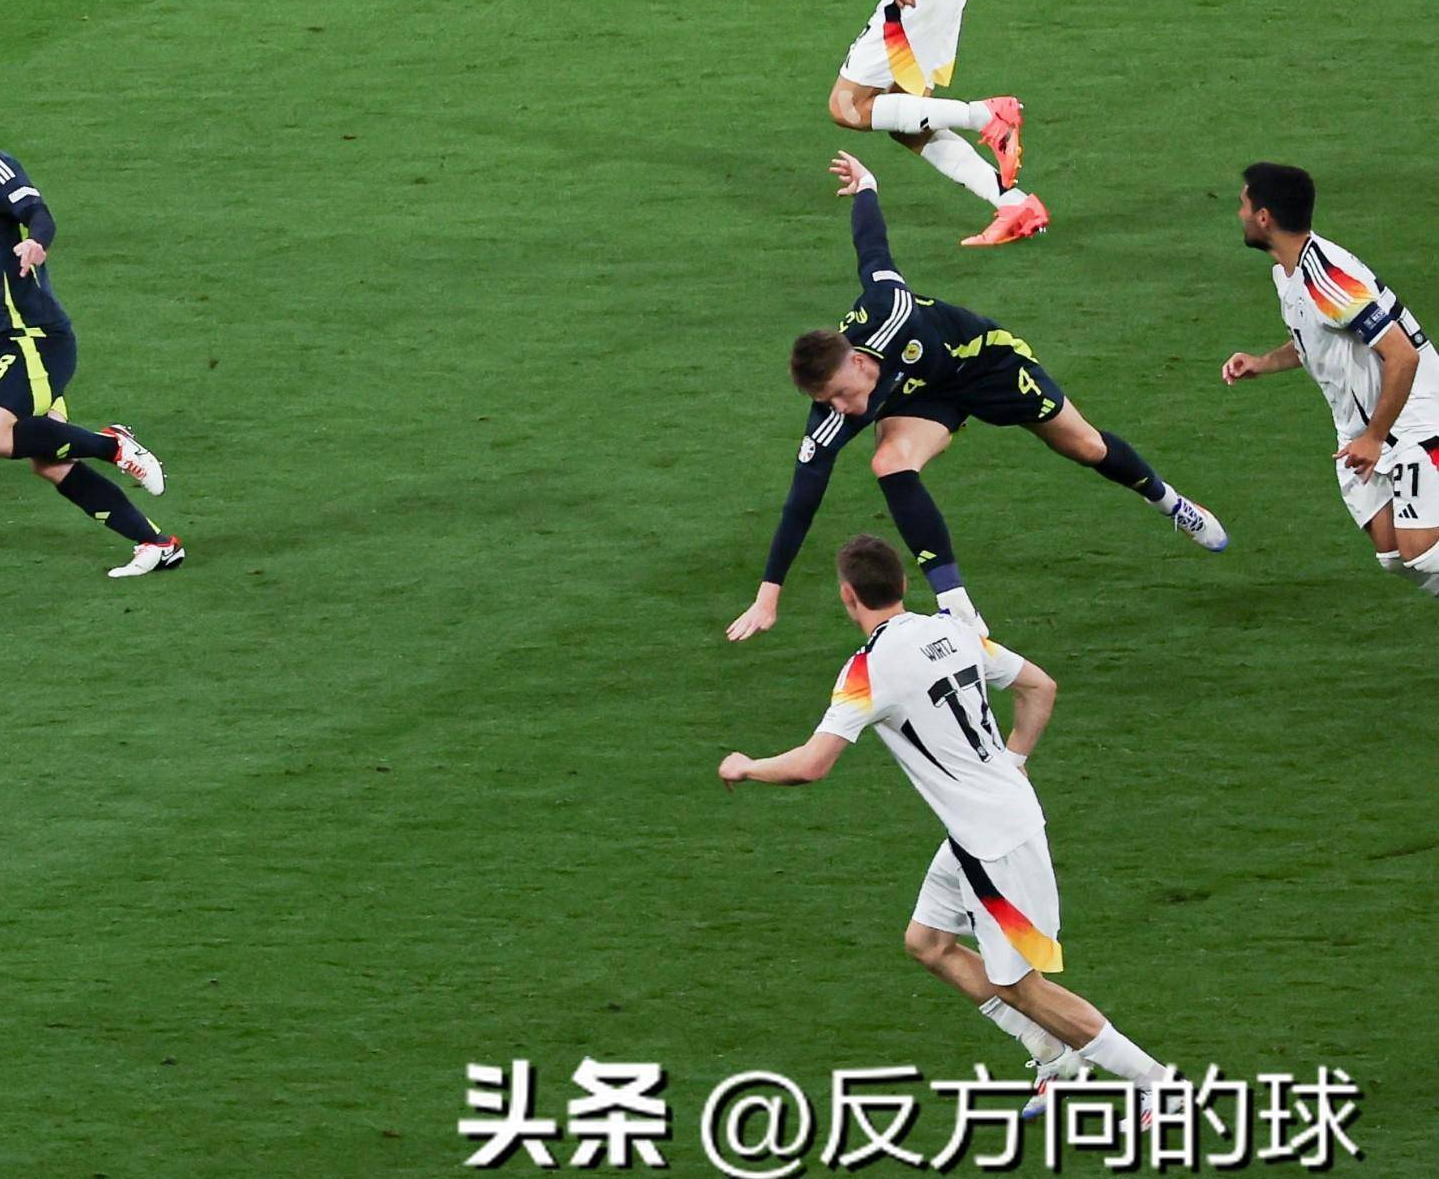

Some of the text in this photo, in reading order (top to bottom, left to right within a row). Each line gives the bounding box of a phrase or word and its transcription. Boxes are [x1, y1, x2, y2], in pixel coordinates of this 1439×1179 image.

[1018, 366, 1042, 397] 4
[1393, 462, 1420, 498] 21
[920, 636, 958, 662] WIRTZ
[927, 664, 1002, 763] 17
